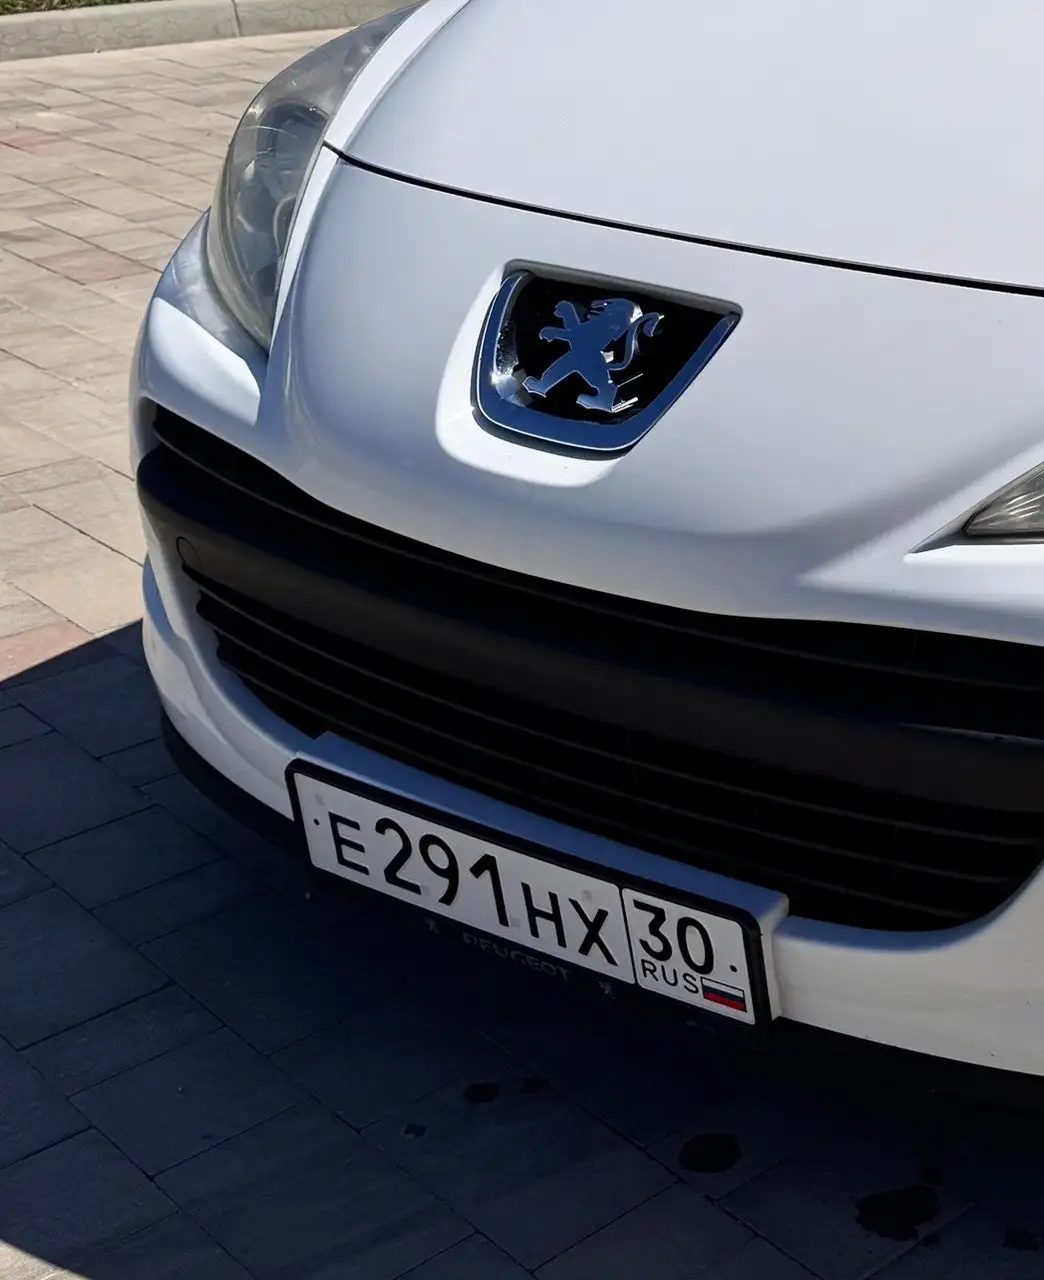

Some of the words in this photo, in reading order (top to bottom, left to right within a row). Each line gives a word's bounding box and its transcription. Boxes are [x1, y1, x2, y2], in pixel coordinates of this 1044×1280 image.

[462, 931, 571, 981] PEUGEOT
[633, 899, 714, 975] 30
[641, 959, 699, 994] RUS
